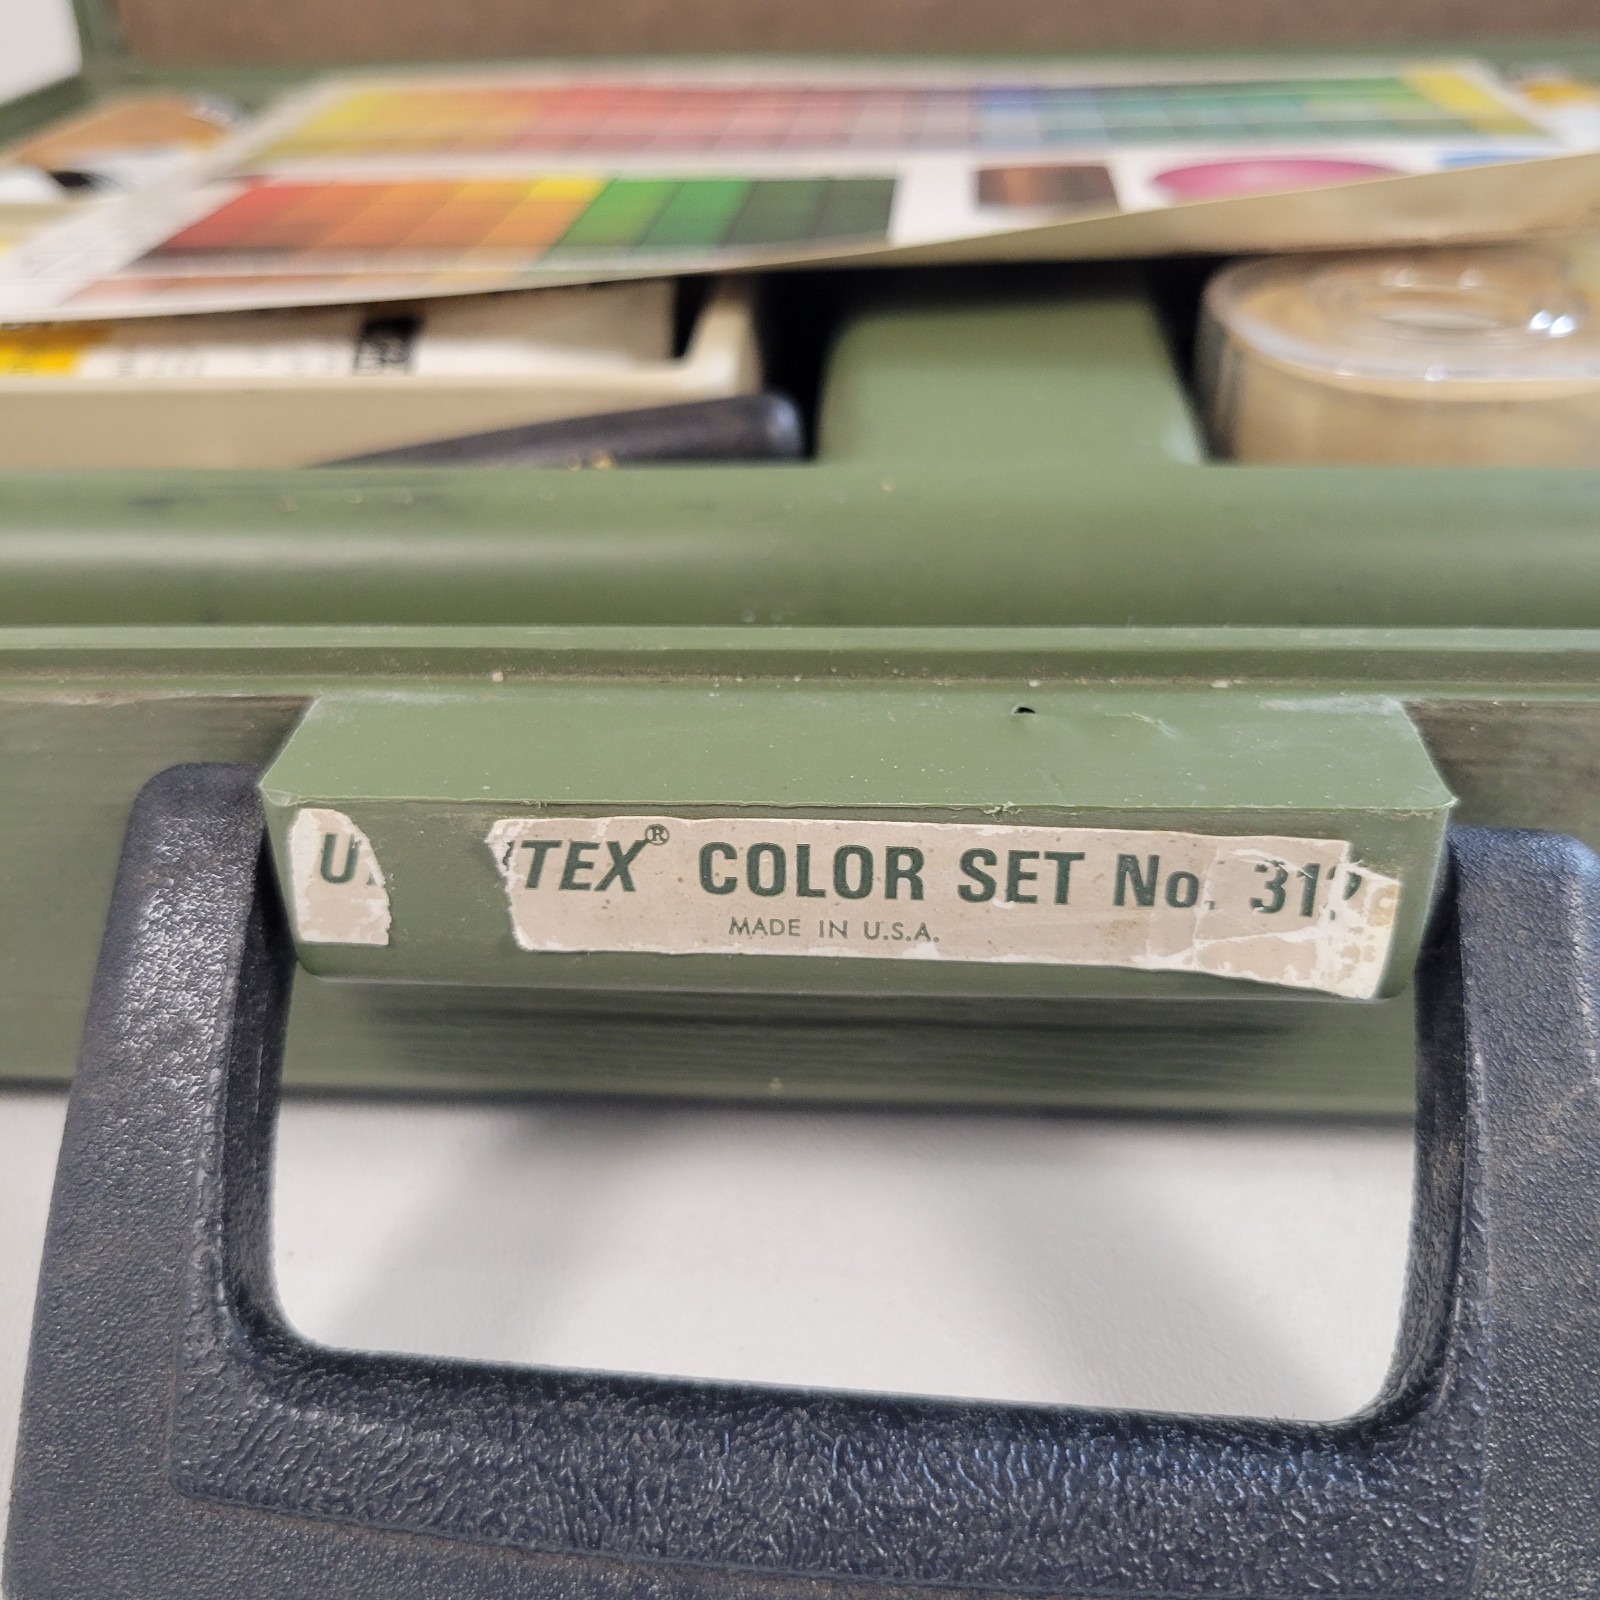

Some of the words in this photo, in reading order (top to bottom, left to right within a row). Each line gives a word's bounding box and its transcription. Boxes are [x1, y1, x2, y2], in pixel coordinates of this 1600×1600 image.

[699, 841, 925, 901] COLOR
[957, 847, 1086, 906] SET
[728, 916, 801, 937] MADE
[818, 919, 848, 939] IN
[864, 921, 940, 943] U.S.A.
